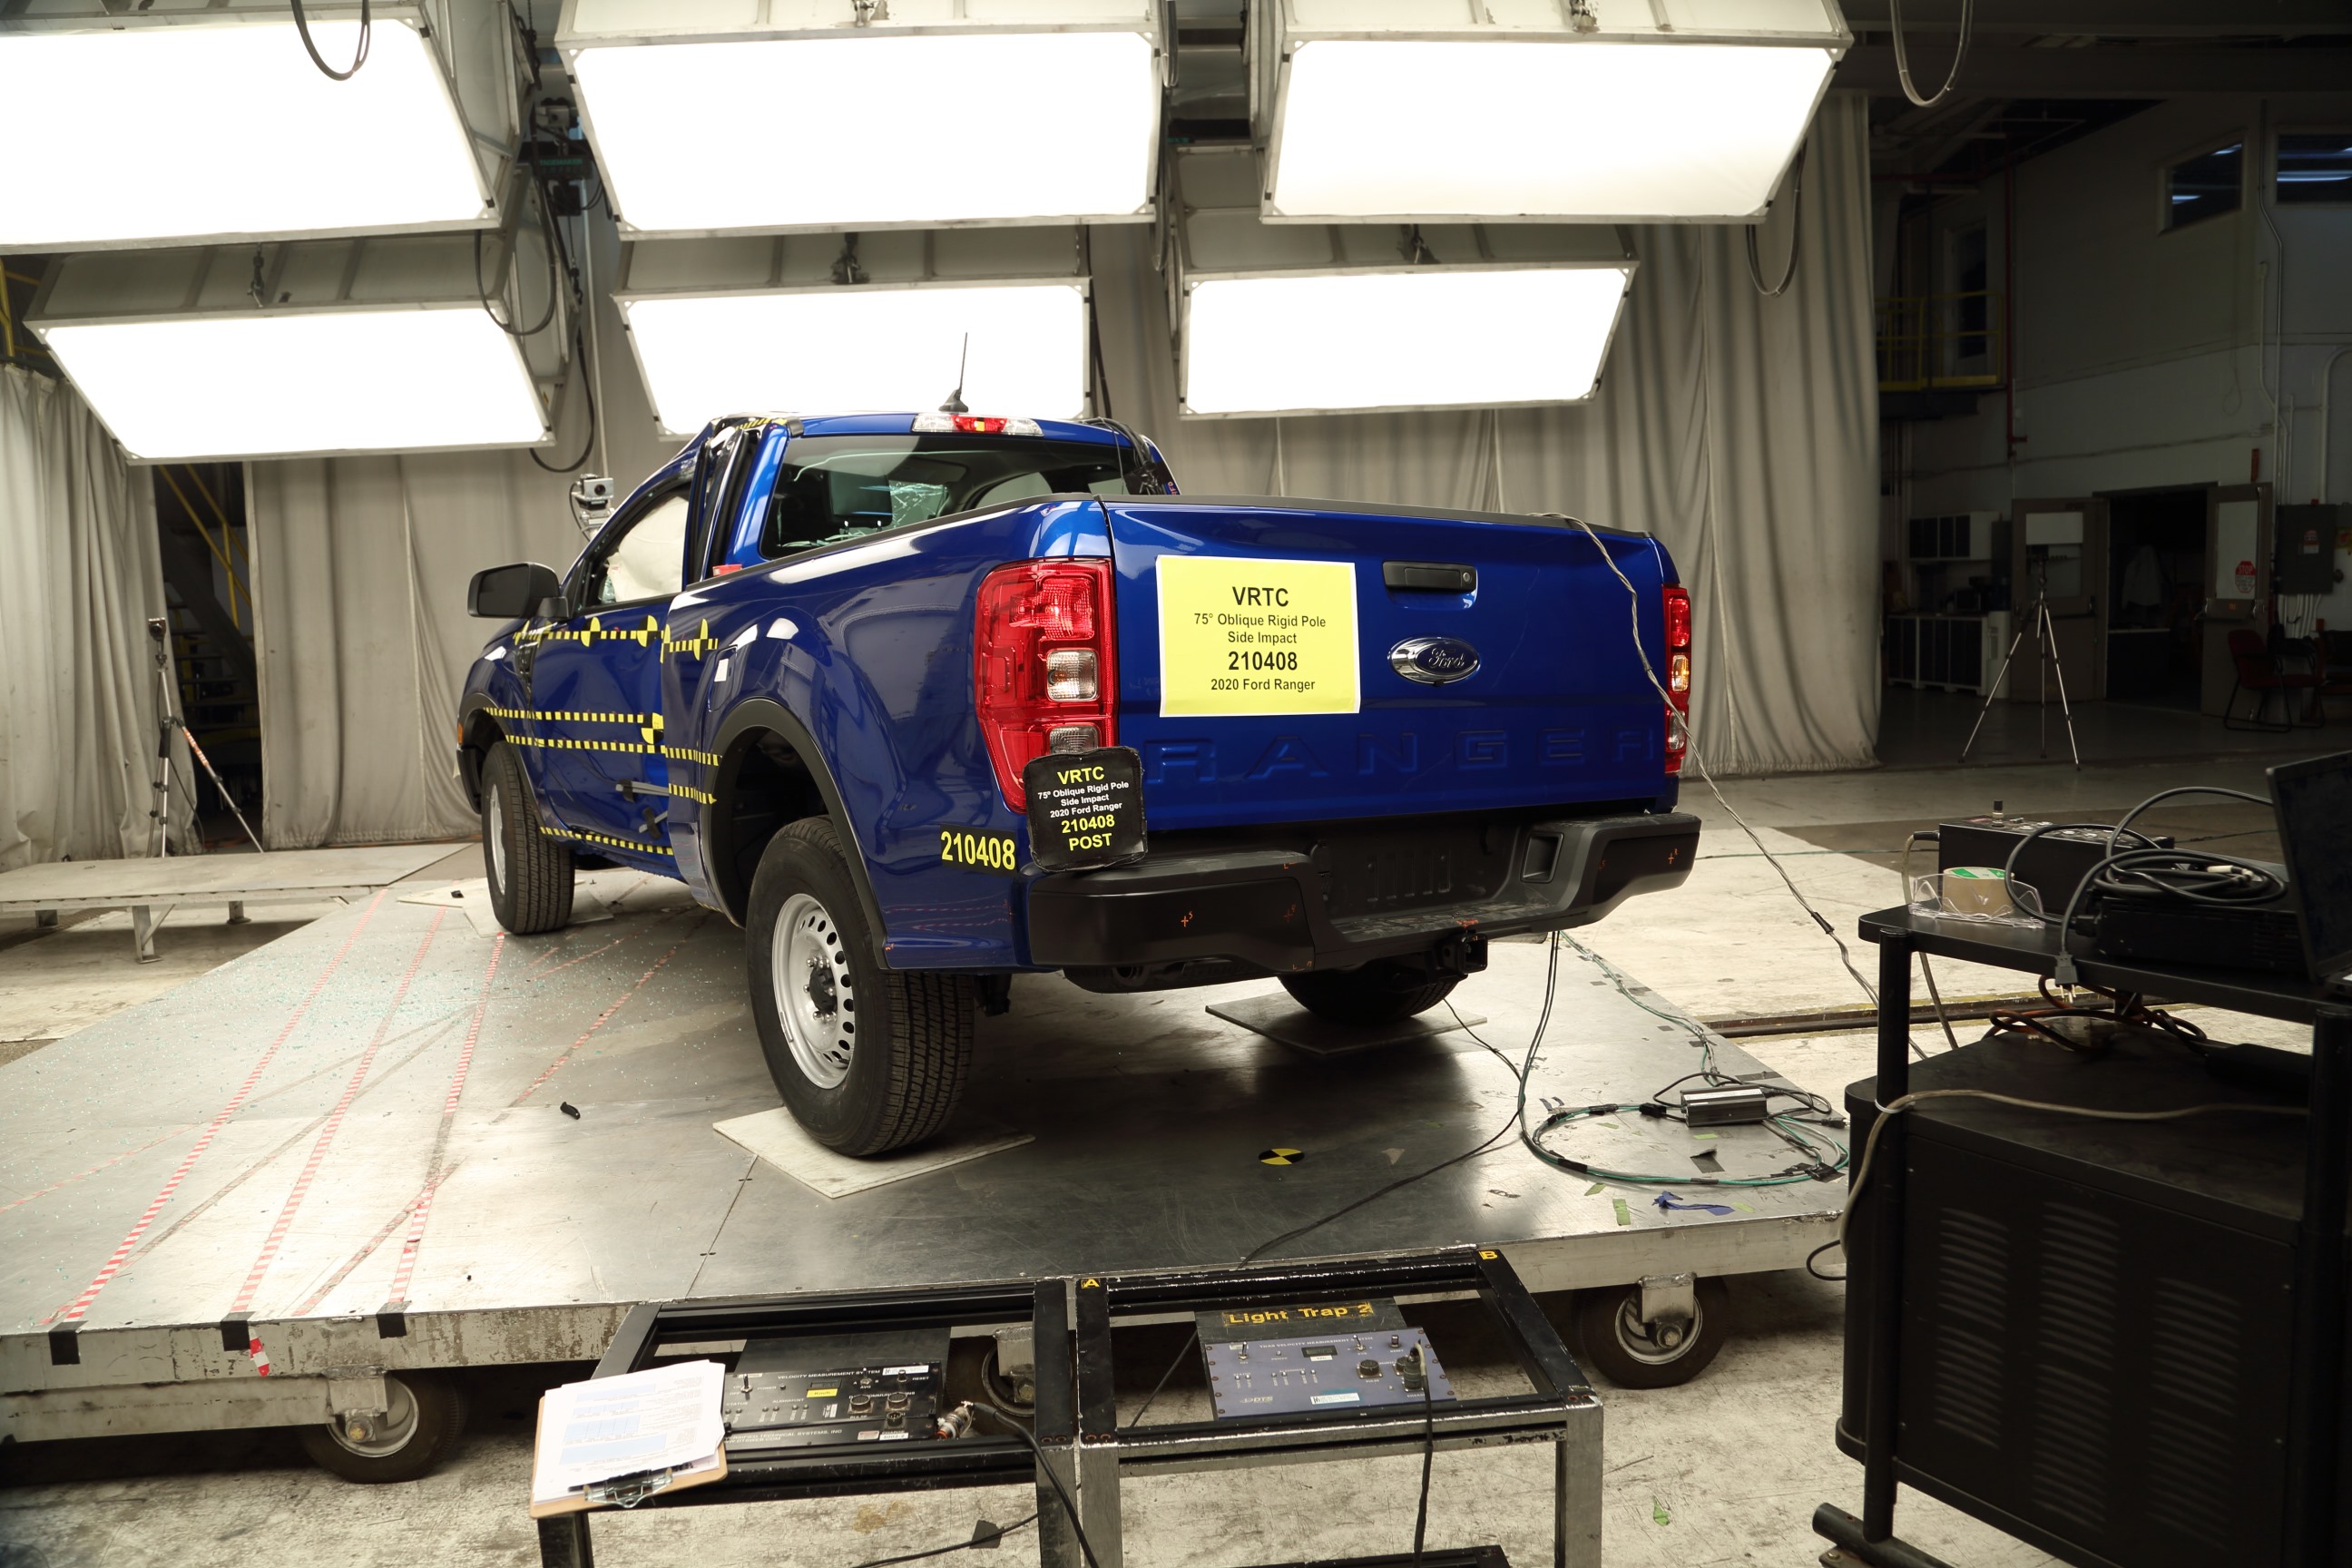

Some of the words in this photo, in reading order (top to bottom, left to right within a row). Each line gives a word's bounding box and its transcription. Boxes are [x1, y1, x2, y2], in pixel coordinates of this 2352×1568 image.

[2238, 564, 2253, 574] STOP
[1231, 585, 1289, 607] VRTC
[1193, 612, 1214, 626] 75°
[1218, 612, 1264, 628] Oblique
[1268, 613, 1298, 630] Rigid
[1301, 614, 1327, 628] Pole
[1227, 630, 1254, 643] Side
[1258, 631, 1298, 646] Impact
[1228, 651, 1298, 671] 210408
[1427, 646, 1466, 670] Ford
[1210, 677, 1240, 691] 2020
[1243, 677, 1270, 691] Ford
[1274, 678, 1316, 693] Ranger
[1145, 727, 1654, 784] RANGER
[1057, 766, 1105, 786] VRTC
[1053, 787, 1085, 800] Oblique
[1087, 783, 1109, 796] Rigid
[1110, 780, 1130, 791] Pole
[1049, 808, 1070, 818] 2020
[1071, 806, 1091, 816] Ford
[1093, 802, 1123, 815] Ranger
[1060, 797, 1080, 808] Side
[1081, 793, 1110, 806] Impact
[1061, 814, 1115, 834] 210408
[940, 830, 1016, 871] 210408
[1068, 833, 1113, 851] POST
[1479, 1250, 1498, 1260] B
[1083, 1279, 1100, 1289] A
[1229, 1309, 1289, 1326] Light
[1298, 1305, 1348, 1320] Trap
[1357, 1303, 1373, 1316] 2
